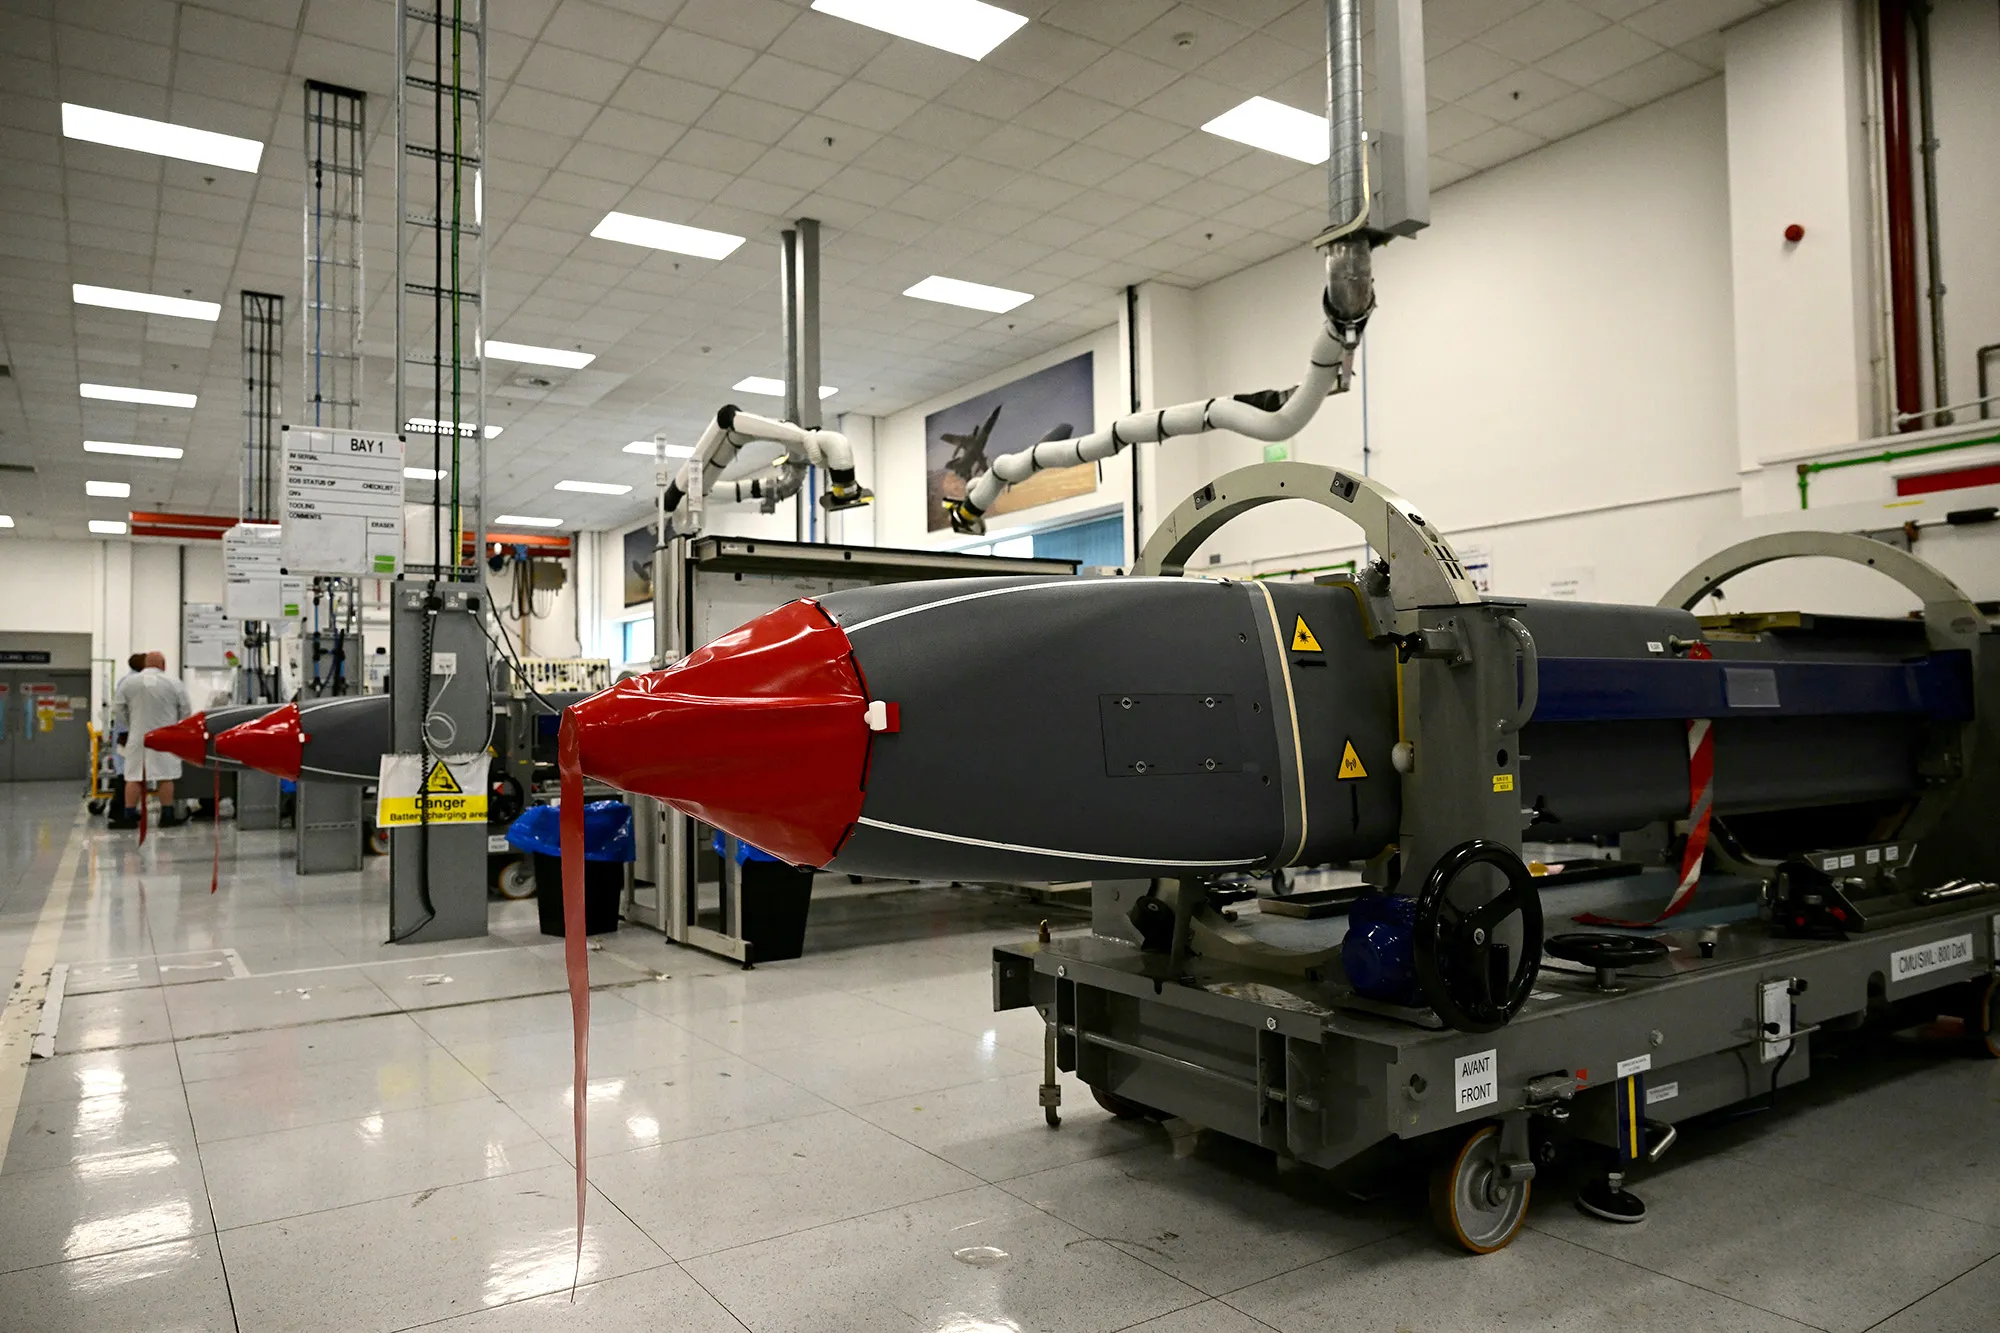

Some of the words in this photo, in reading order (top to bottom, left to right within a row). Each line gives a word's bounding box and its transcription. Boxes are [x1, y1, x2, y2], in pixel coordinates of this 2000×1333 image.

[351, 438, 374, 452] BAY
[378, 441, 383, 453] 1
[303, 478, 326, 486] STATUS
[362, 483, 393, 491] CHECKLIST
[289, 502, 315, 510] TOOLING
[289, 511, 322, 520] COMMENTS
[371, 521, 395, 529] ERASER
[415, 798, 466, 811] Danger
[427, 811, 466, 820] charging
[1462, 1057, 1490, 1077] AVANT
[1461, 1083, 1492, 1104] FRONT
